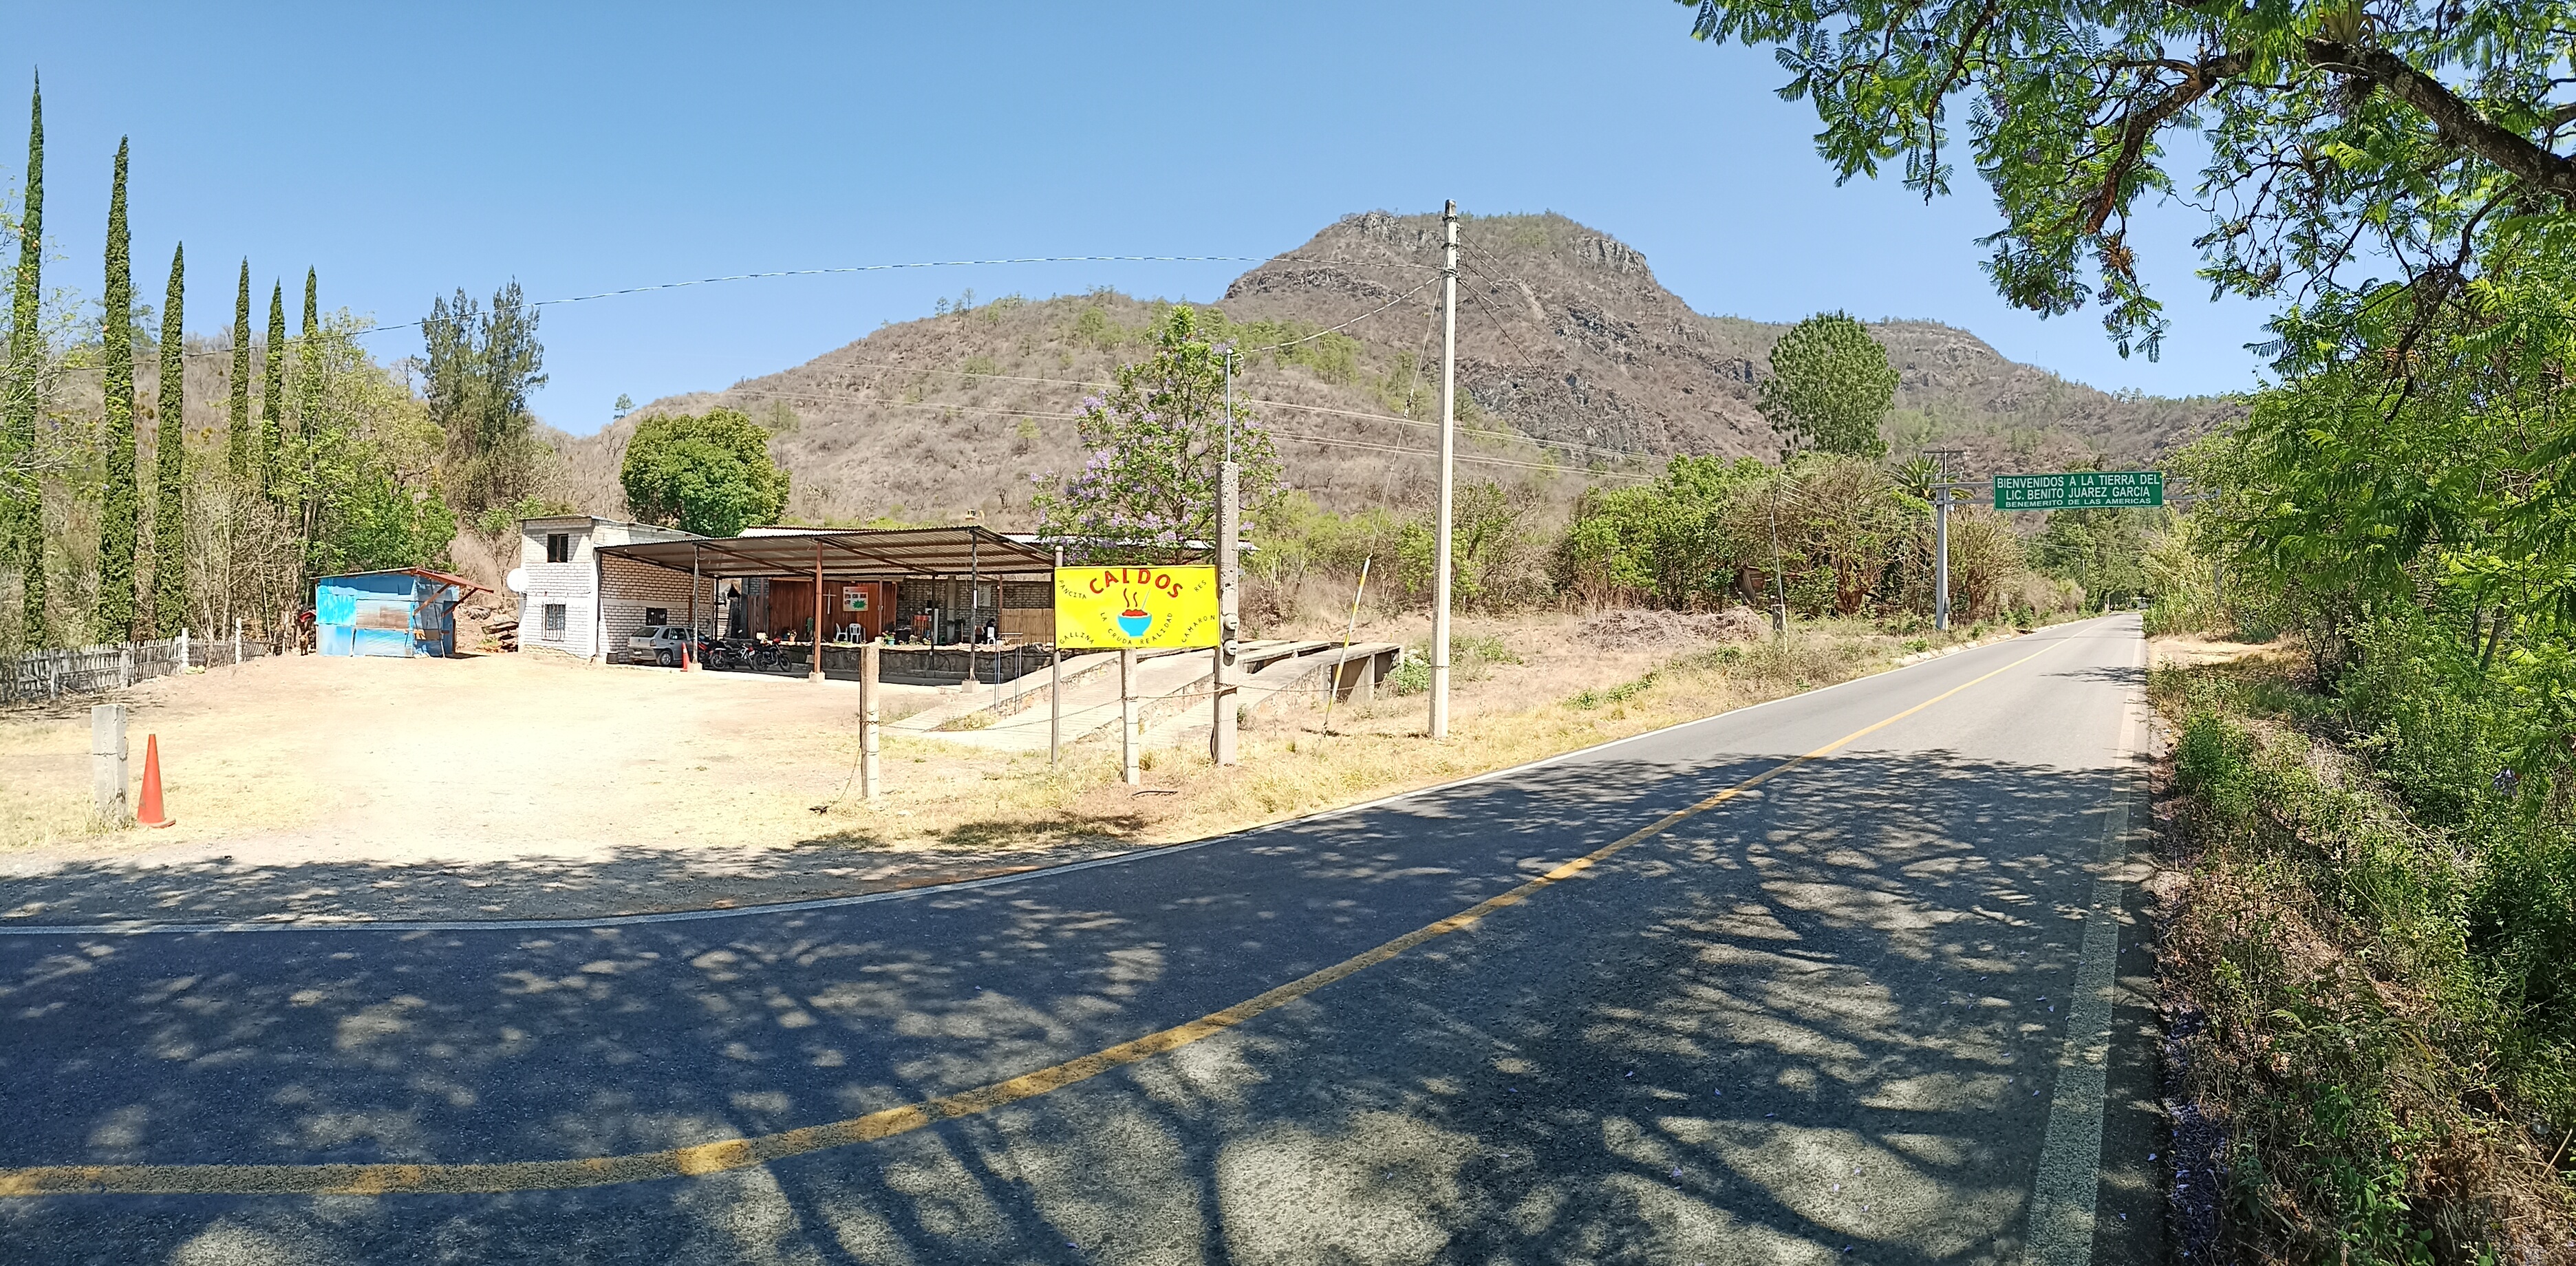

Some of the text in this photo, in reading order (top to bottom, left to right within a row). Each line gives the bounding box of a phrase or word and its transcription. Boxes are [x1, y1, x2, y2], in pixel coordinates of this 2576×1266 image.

[1997, 474, 2160, 489] BIENVENIDOS A LA TIERRA DEL
[2006, 486, 2150, 500] LIC. BENITO JUAREZ GARCIA
[2006, 500, 2063, 508] BENEMERITO
[1058, 580, 1086, 599] PANCITA
[1089, 568, 1183, 598] CALDOS
[1194, 579, 1207, 592] RES
[1100, 612, 1172, 645] LA CRUDA REALIDAD
[1181, 615, 1215, 643] CAMARON
[1059, 632, 1095, 645] GALLINA
